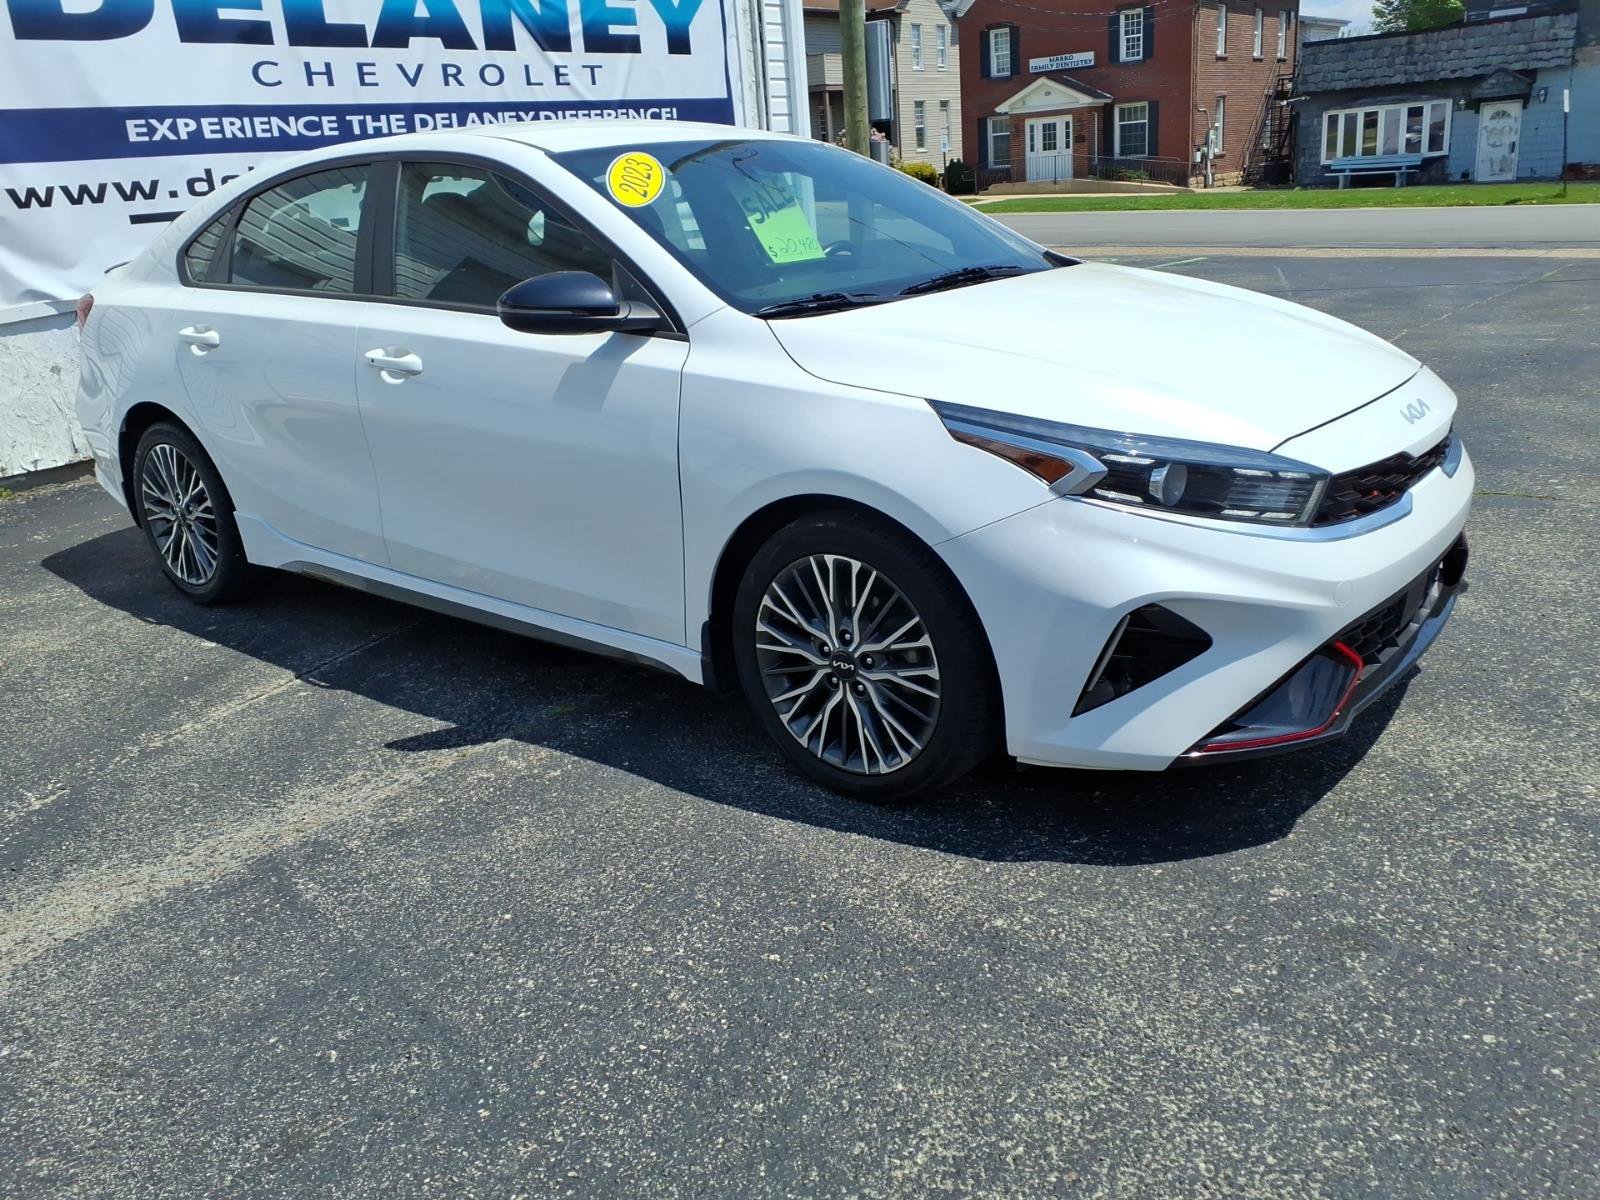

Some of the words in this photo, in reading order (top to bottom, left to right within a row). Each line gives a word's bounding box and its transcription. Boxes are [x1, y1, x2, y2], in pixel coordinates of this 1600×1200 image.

[251, 60, 603, 88] CHEVROLET
[1031, 62, 1054, 71] FAMILY
[1056, 59, 1093, 68] DENTISTRY
[125, 115, 339, 142] EXPERIENCE
[346, 113, 406, 135] THE
[4, 166, 255, 210] www.d
[619, 158, 653, 198] 2023
[1399, 398, 1431, 425] KIA
